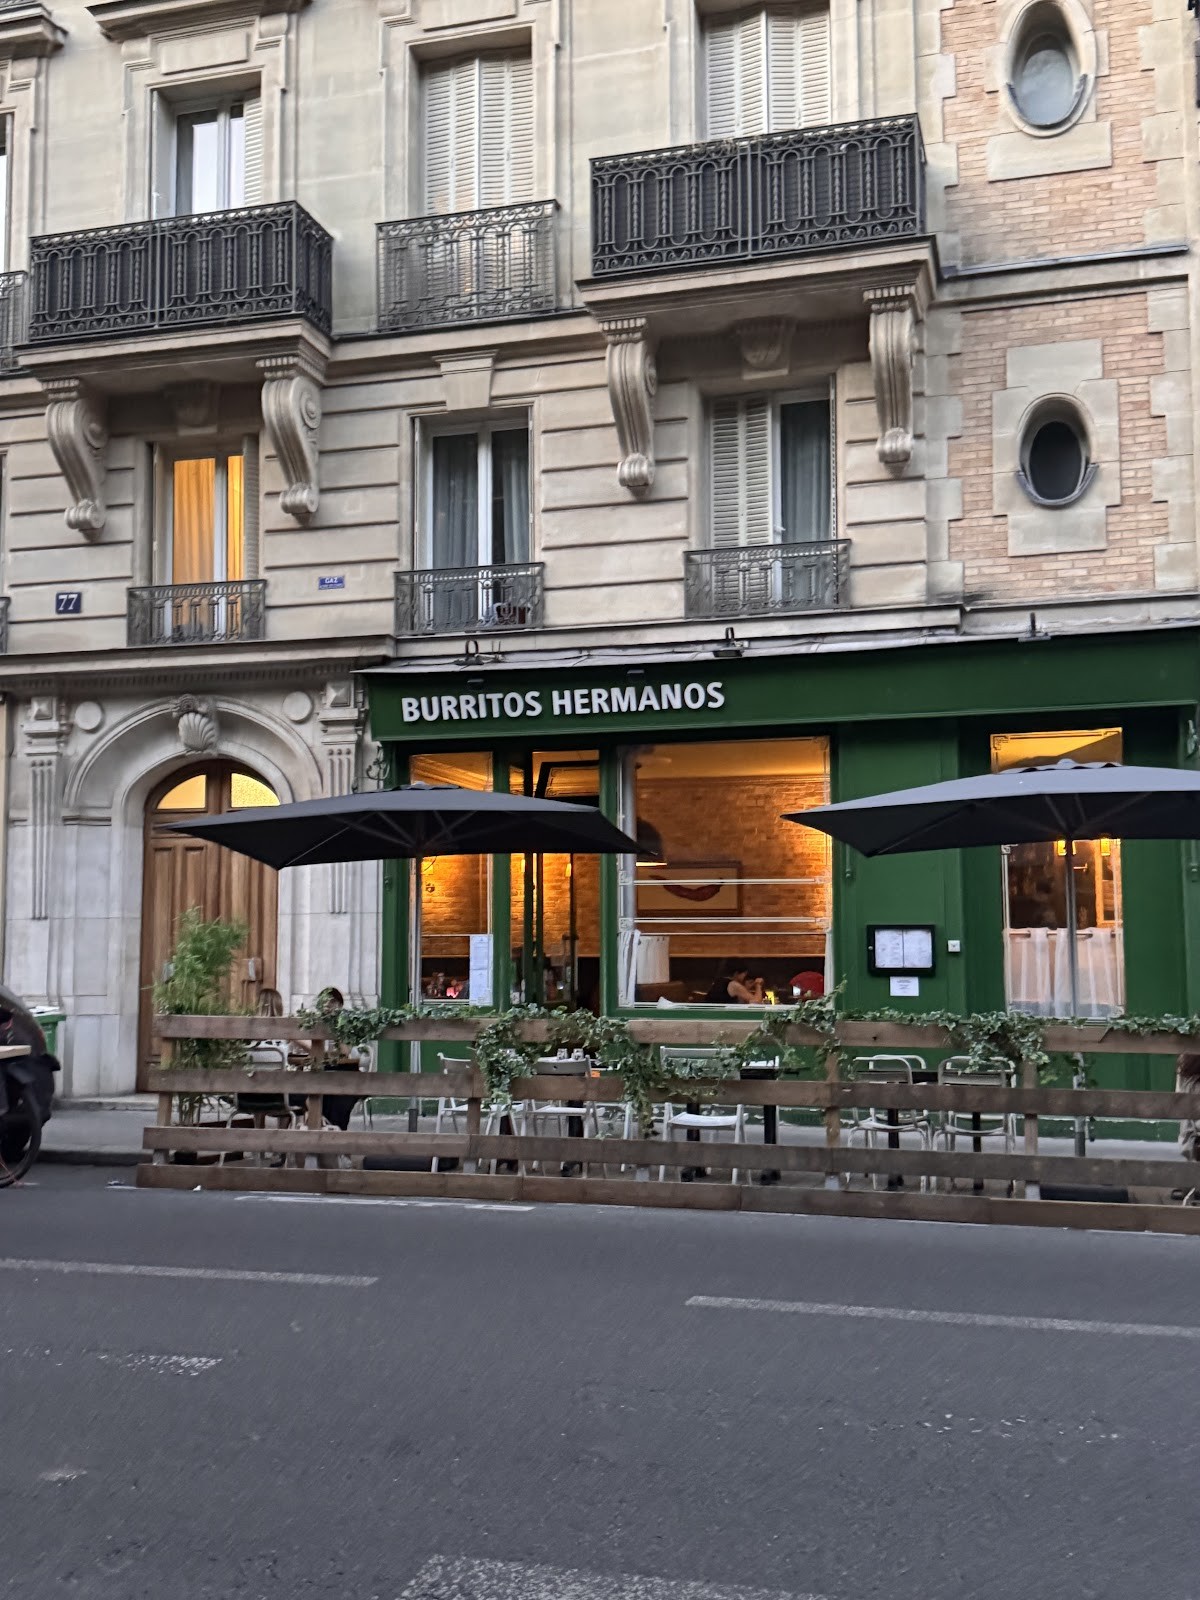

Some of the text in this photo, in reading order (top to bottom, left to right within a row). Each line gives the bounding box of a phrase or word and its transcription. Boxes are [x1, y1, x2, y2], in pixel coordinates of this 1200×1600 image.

[324, 576, 339, 584] GAZ
[58, 593, 79, 611] 77
[401, 681, 726, 722] BURRITOS HERMANOS
